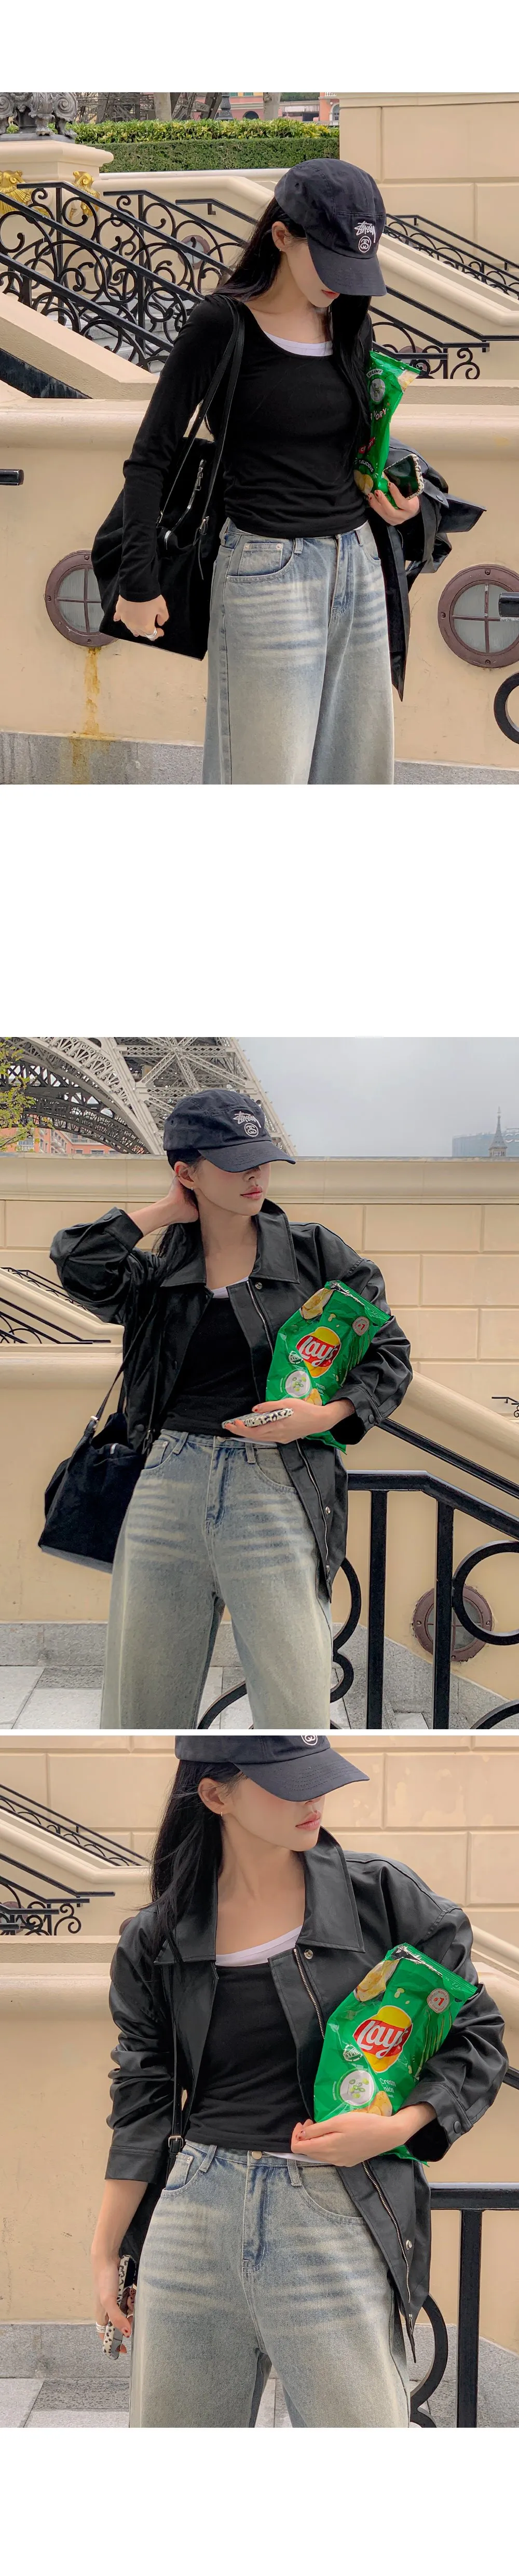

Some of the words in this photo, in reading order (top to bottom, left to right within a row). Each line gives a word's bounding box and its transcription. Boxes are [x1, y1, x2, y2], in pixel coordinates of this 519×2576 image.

[367, 369, 383, 377] CREAMY
[356, 2020, 409, 2060] Lay's
[379, 2078, 397, 2087] Cream
[384, 2085, 394, 2093] nion
